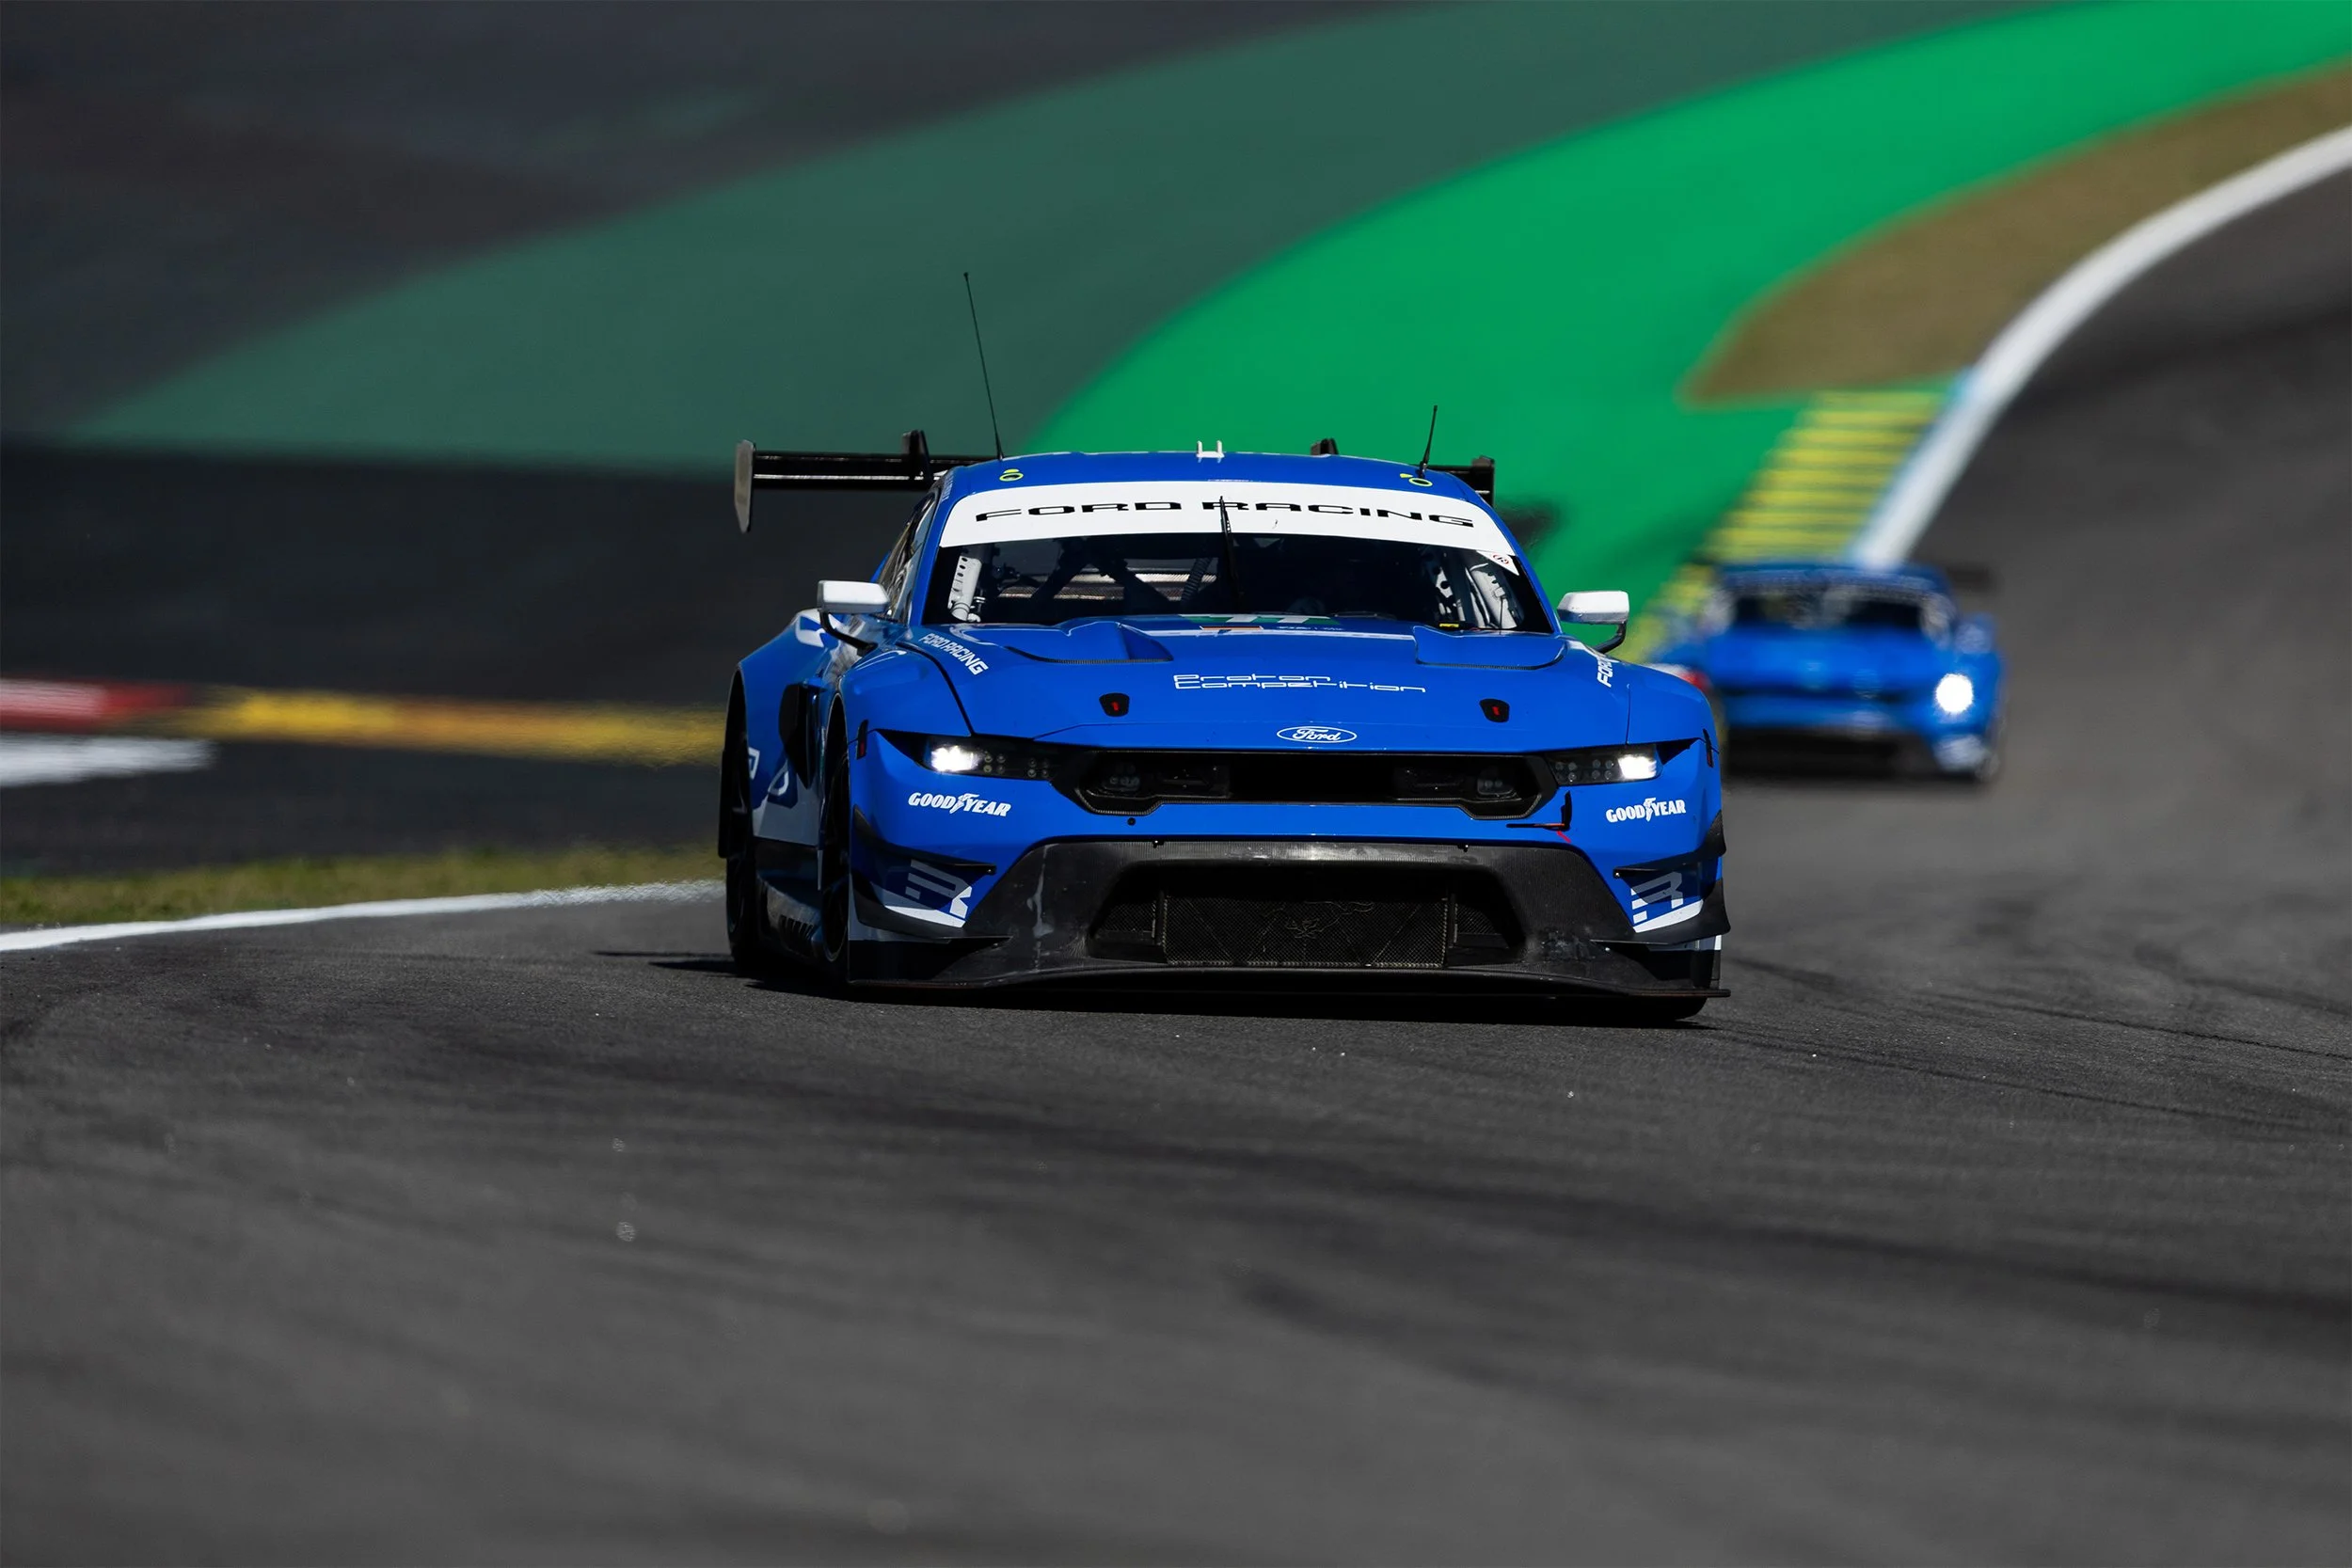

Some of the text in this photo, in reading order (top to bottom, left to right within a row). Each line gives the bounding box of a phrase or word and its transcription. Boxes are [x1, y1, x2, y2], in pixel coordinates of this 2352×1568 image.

[976, 501, 1474, 528] FORD RACING
[918, 633, 989, 675] FORD RACING
[1173, 673, 1331, 682] Proton
[1174, 680, 1426, 693] Competition
[1292, 727, 1342, 741] Ford
[908, 792, 1011, 817] GOODYEAR
[1605, 797, 1686, 823] GOODYEAR
